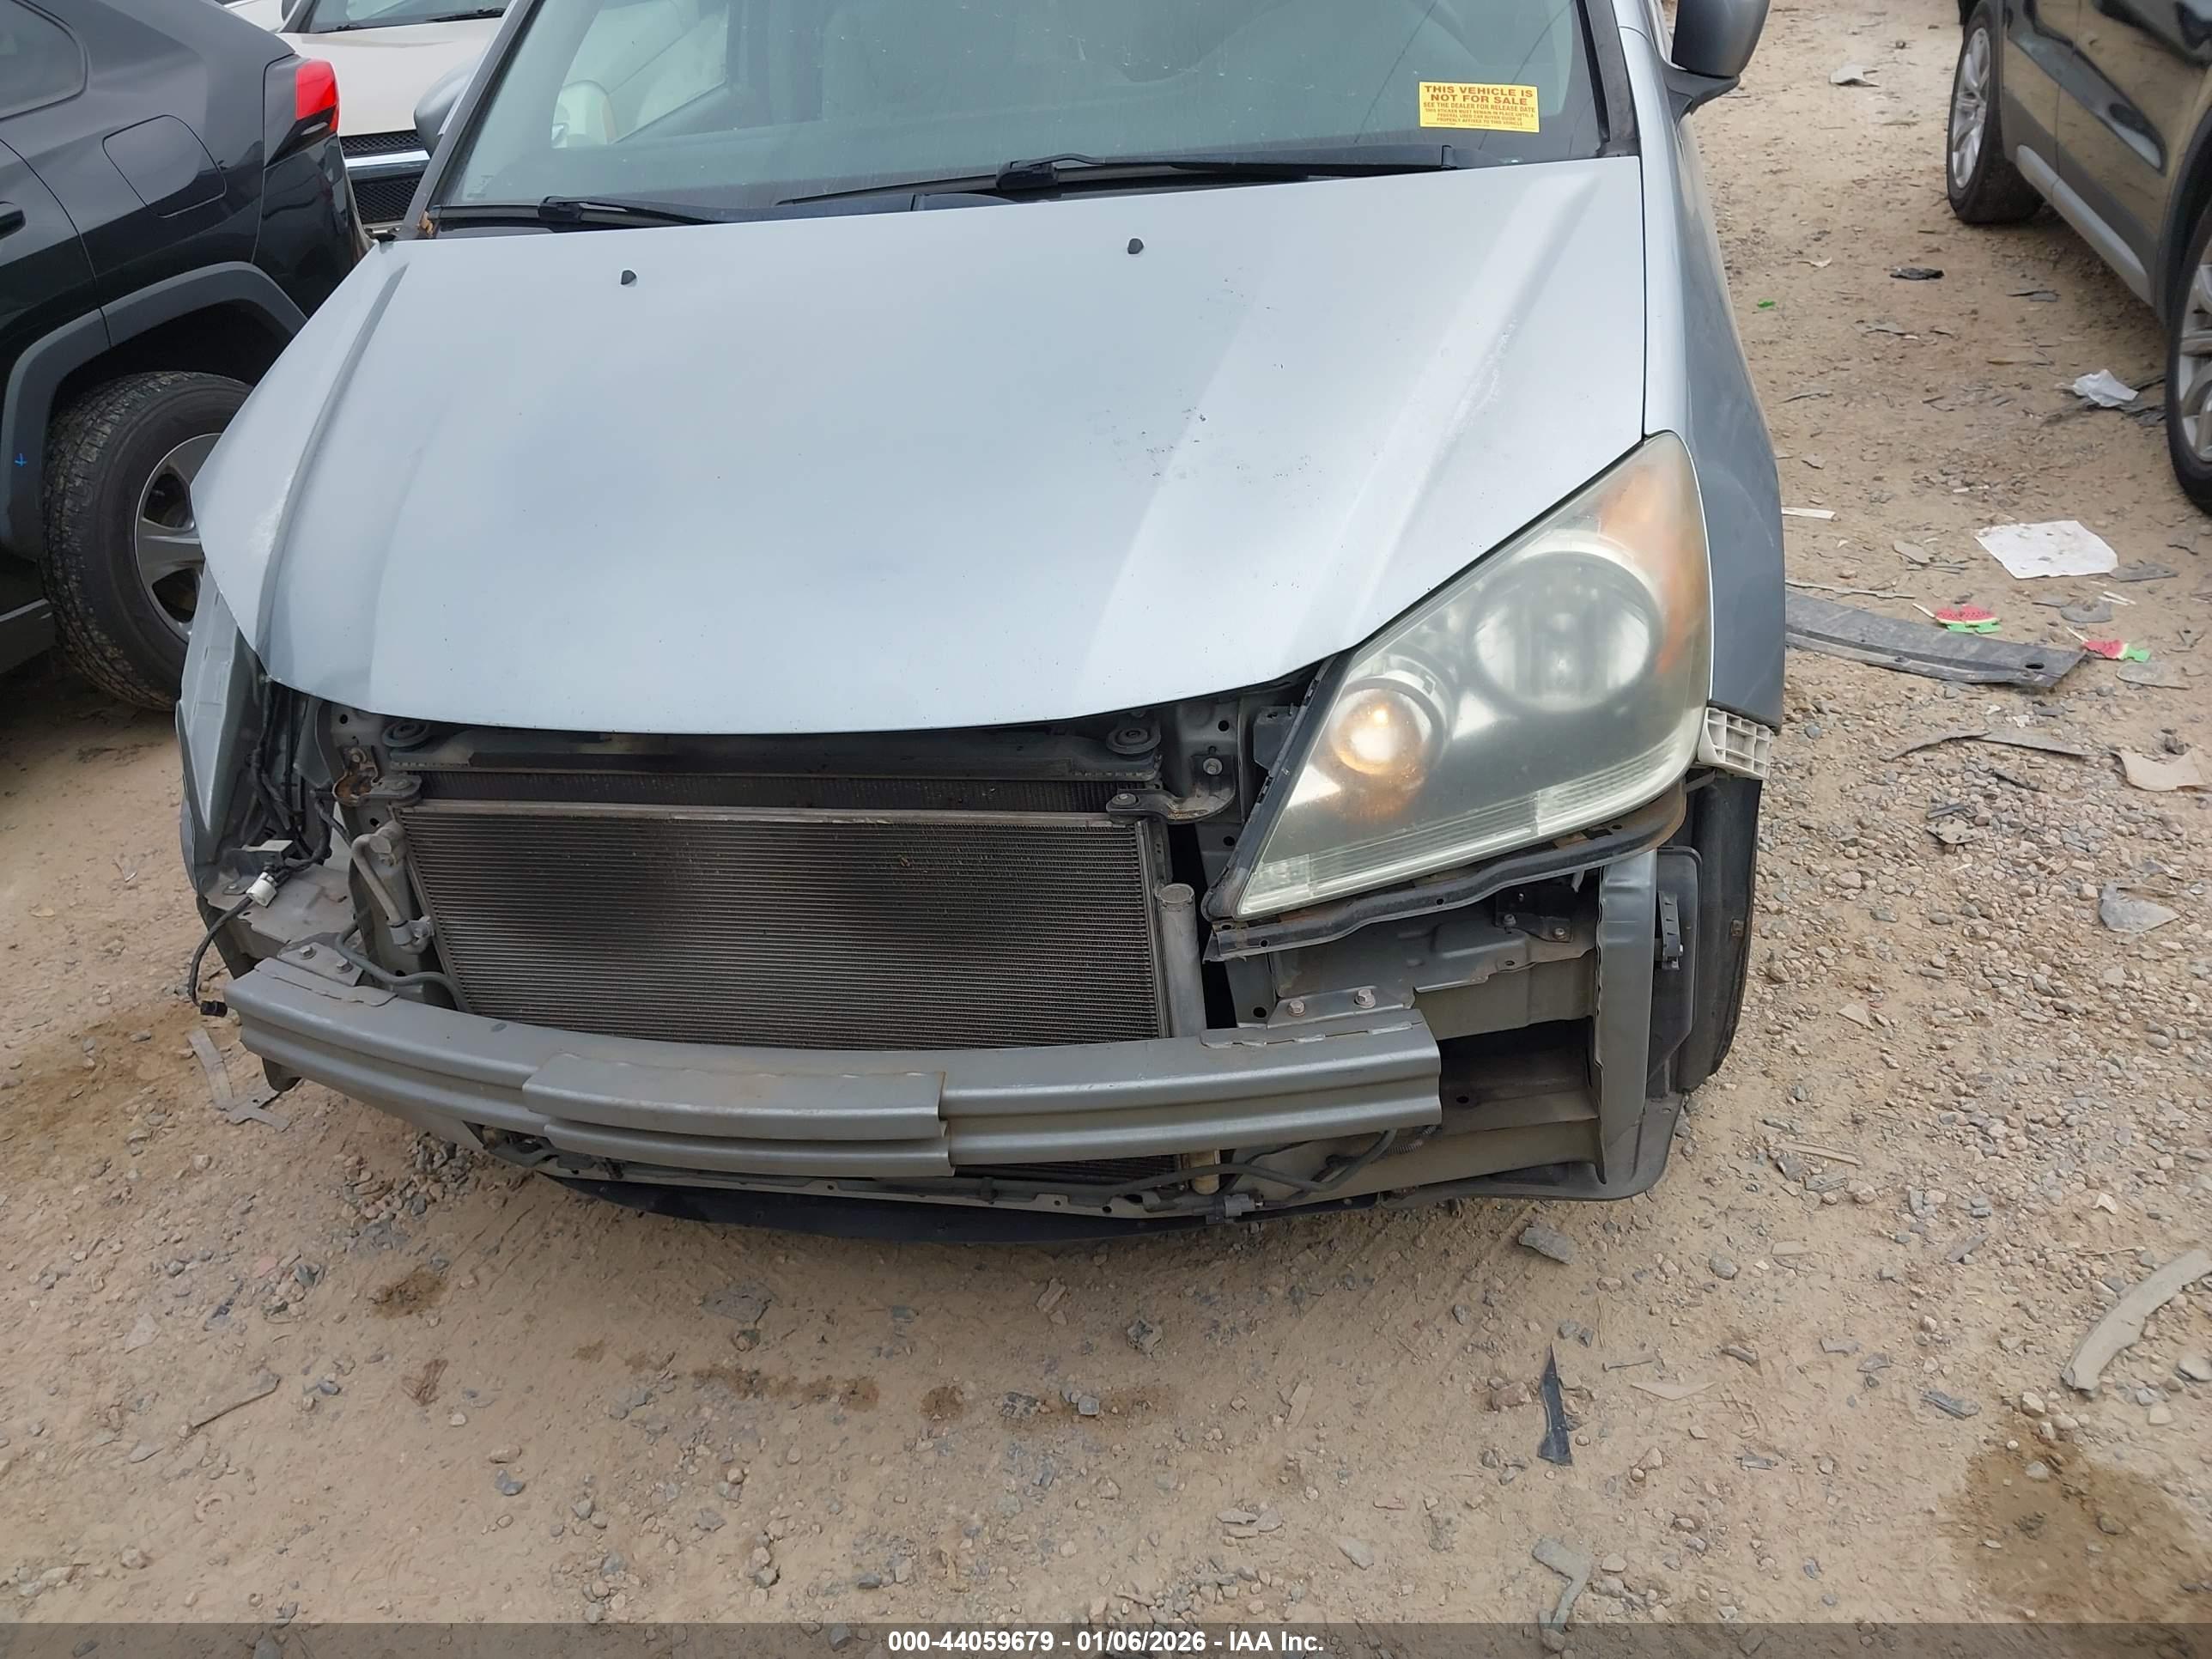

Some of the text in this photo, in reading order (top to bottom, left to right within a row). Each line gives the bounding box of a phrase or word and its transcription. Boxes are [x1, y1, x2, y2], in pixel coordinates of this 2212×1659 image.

[1459, 87, 1516, 96] VEHICLE
[1431, 94, 1458, 102] NOT
[1494, 96, 1528, 106] SALE
